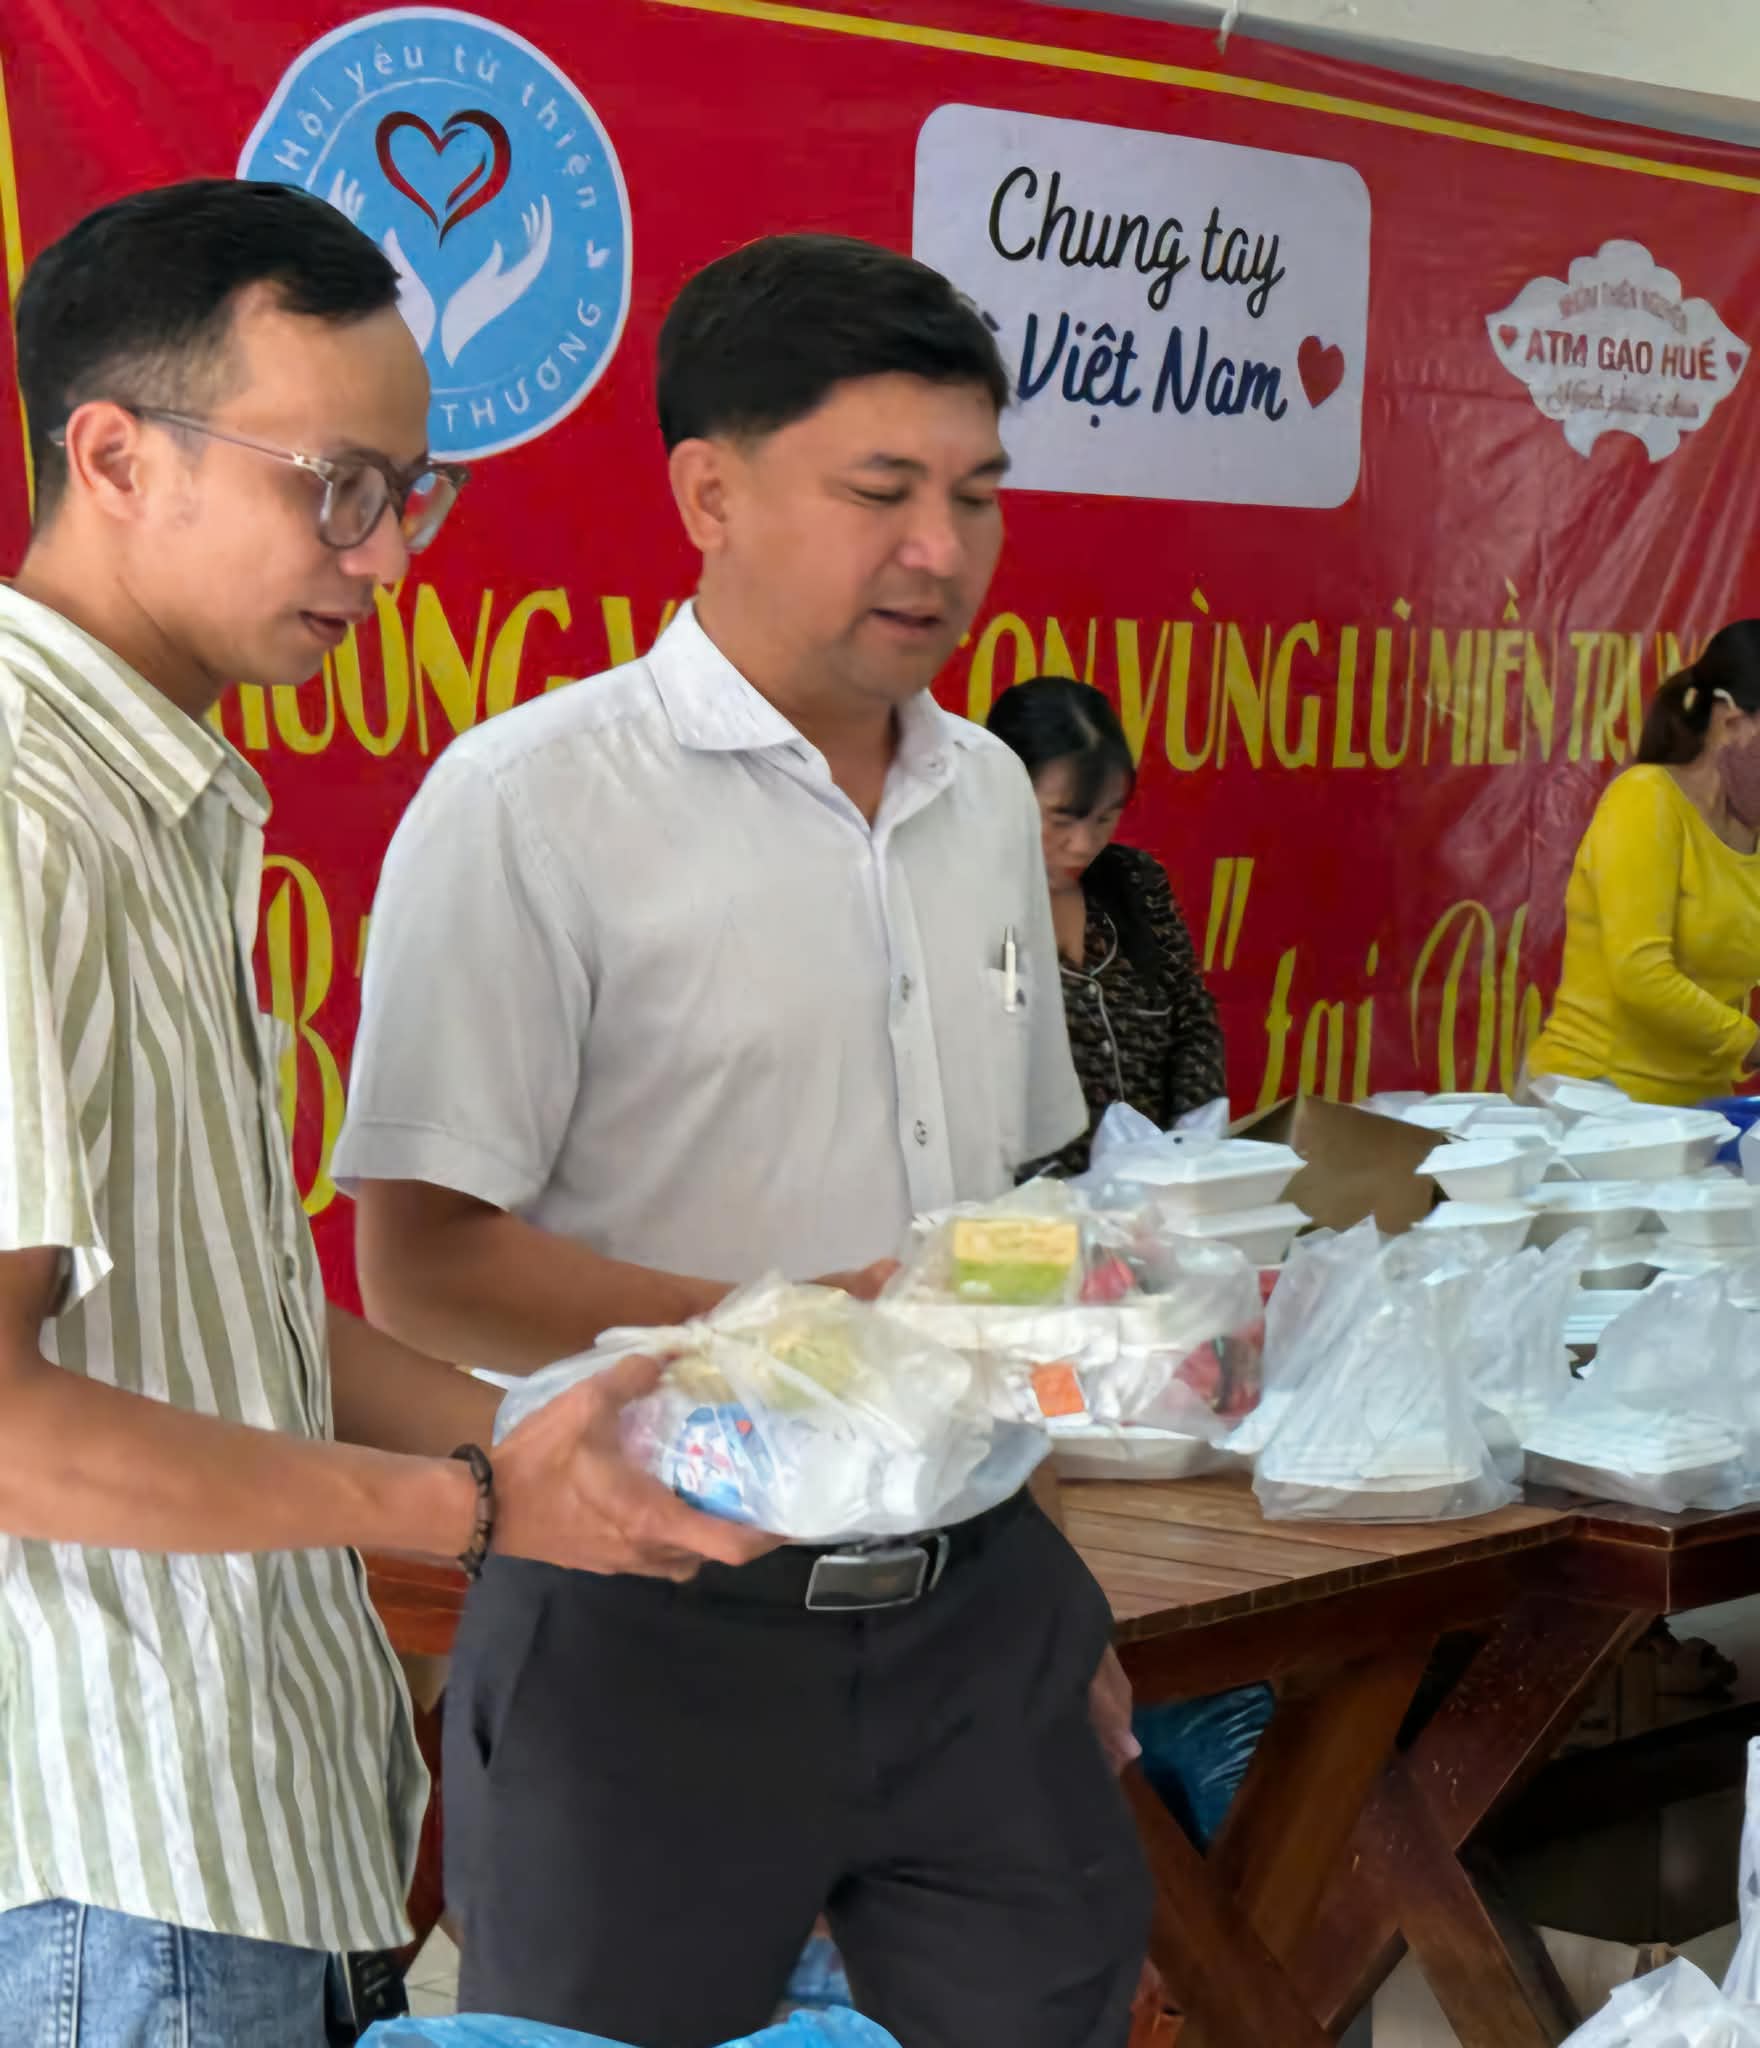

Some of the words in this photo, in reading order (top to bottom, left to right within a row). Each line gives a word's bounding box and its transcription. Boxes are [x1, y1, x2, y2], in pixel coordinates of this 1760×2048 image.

[343, 42, 425, 97] yêu
[988, 165, 1190, 311] Chung
[1199, 206, 1286, 318] tay
[1016, 311, 1141, 428] Việt
[1151, 325, 1288, 421] Nam
[1525, 327, 1588, 368] ATM
[1597, 336, 1654, 381] GẠO
[1115, 586, 1321, 773] VÙNG
[1421, 575, 1558, 767] MIỀN
